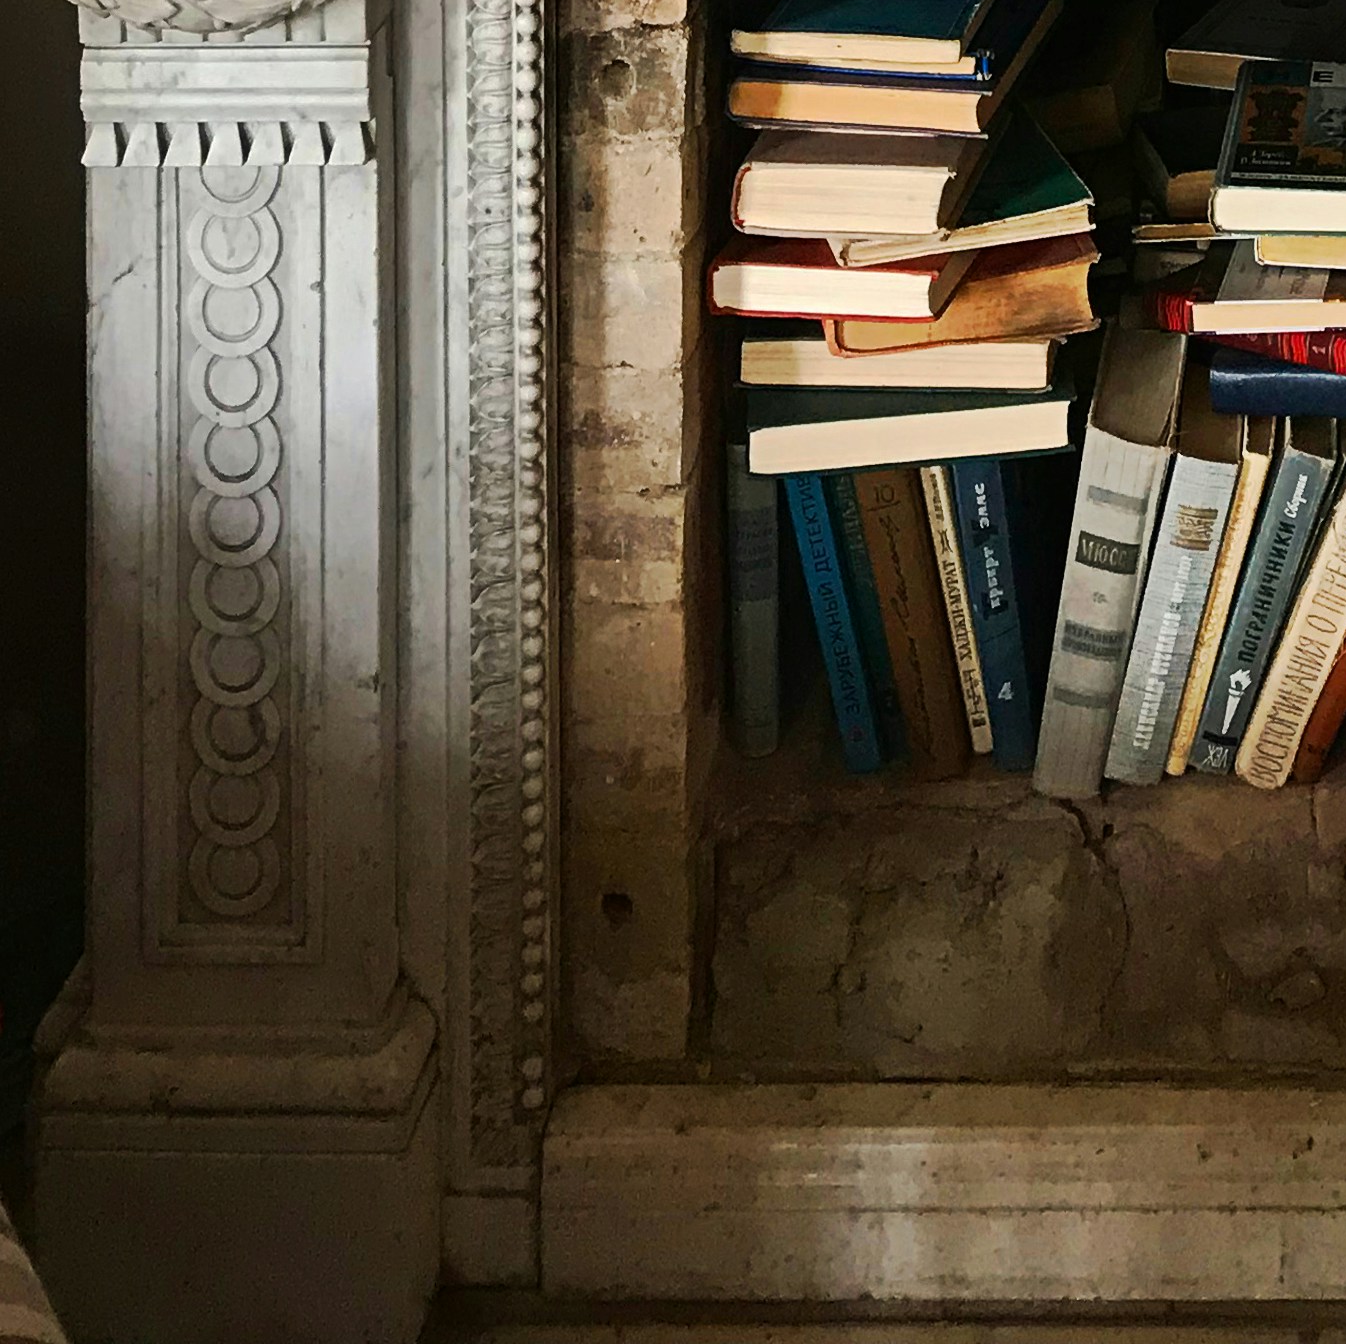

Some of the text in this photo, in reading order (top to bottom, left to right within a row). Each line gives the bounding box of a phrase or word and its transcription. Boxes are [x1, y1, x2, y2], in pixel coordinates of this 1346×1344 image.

[873, 483, 894, 504] 10
[815, 580, 860, 717] ЗАРУБЕЖНЫЙ
[940, 559, 972, 662] ХАДЖИ-МУРАТ
[1237, 519, 1295, 664] ПОГРАНИЧНИКИ
[1248, 632, 1331, 786] ВОСПОМИНАНИЯ
[1311, 609, 1337, 637] О
